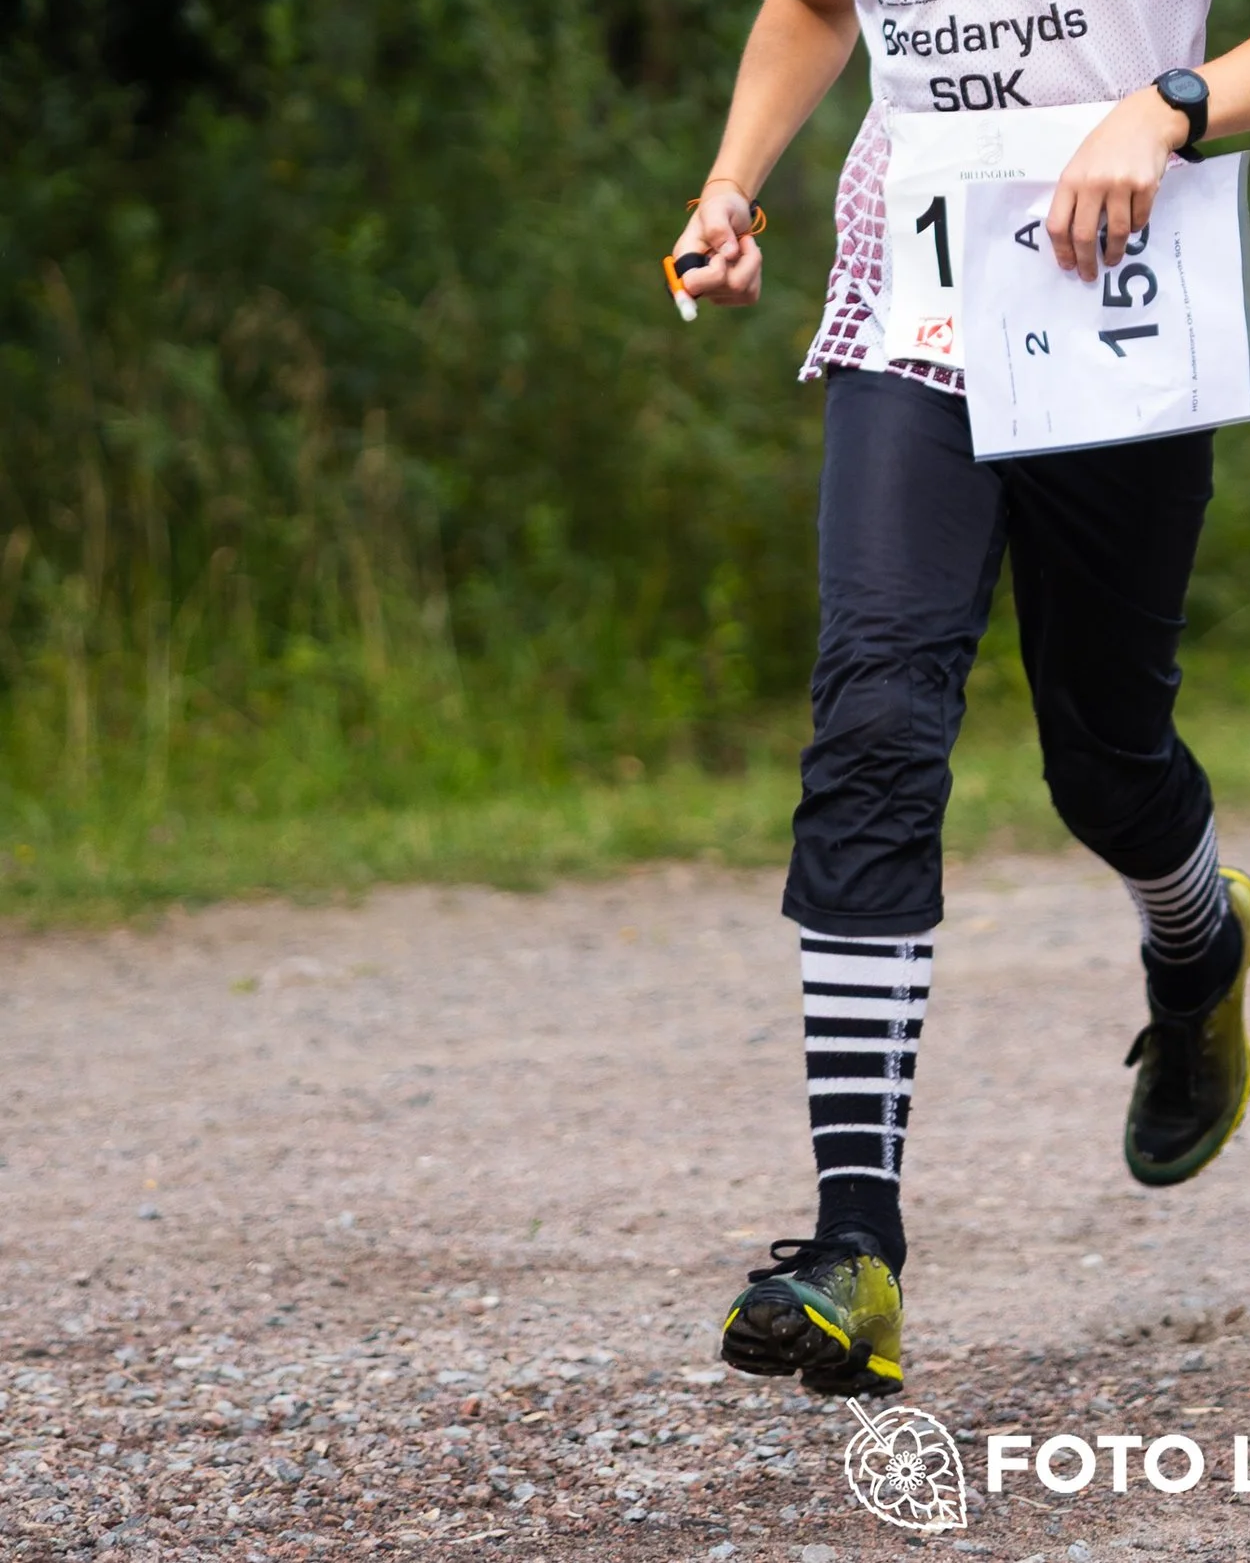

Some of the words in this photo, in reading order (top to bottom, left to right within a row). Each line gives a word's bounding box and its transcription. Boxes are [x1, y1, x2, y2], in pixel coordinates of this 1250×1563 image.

[883, 3, 1088, 57] Bredaryds
[930, 69, 1032, 112] SOK
[1014, 220, 1041, 252] A
[1025, 330, 1051, 356] 2
